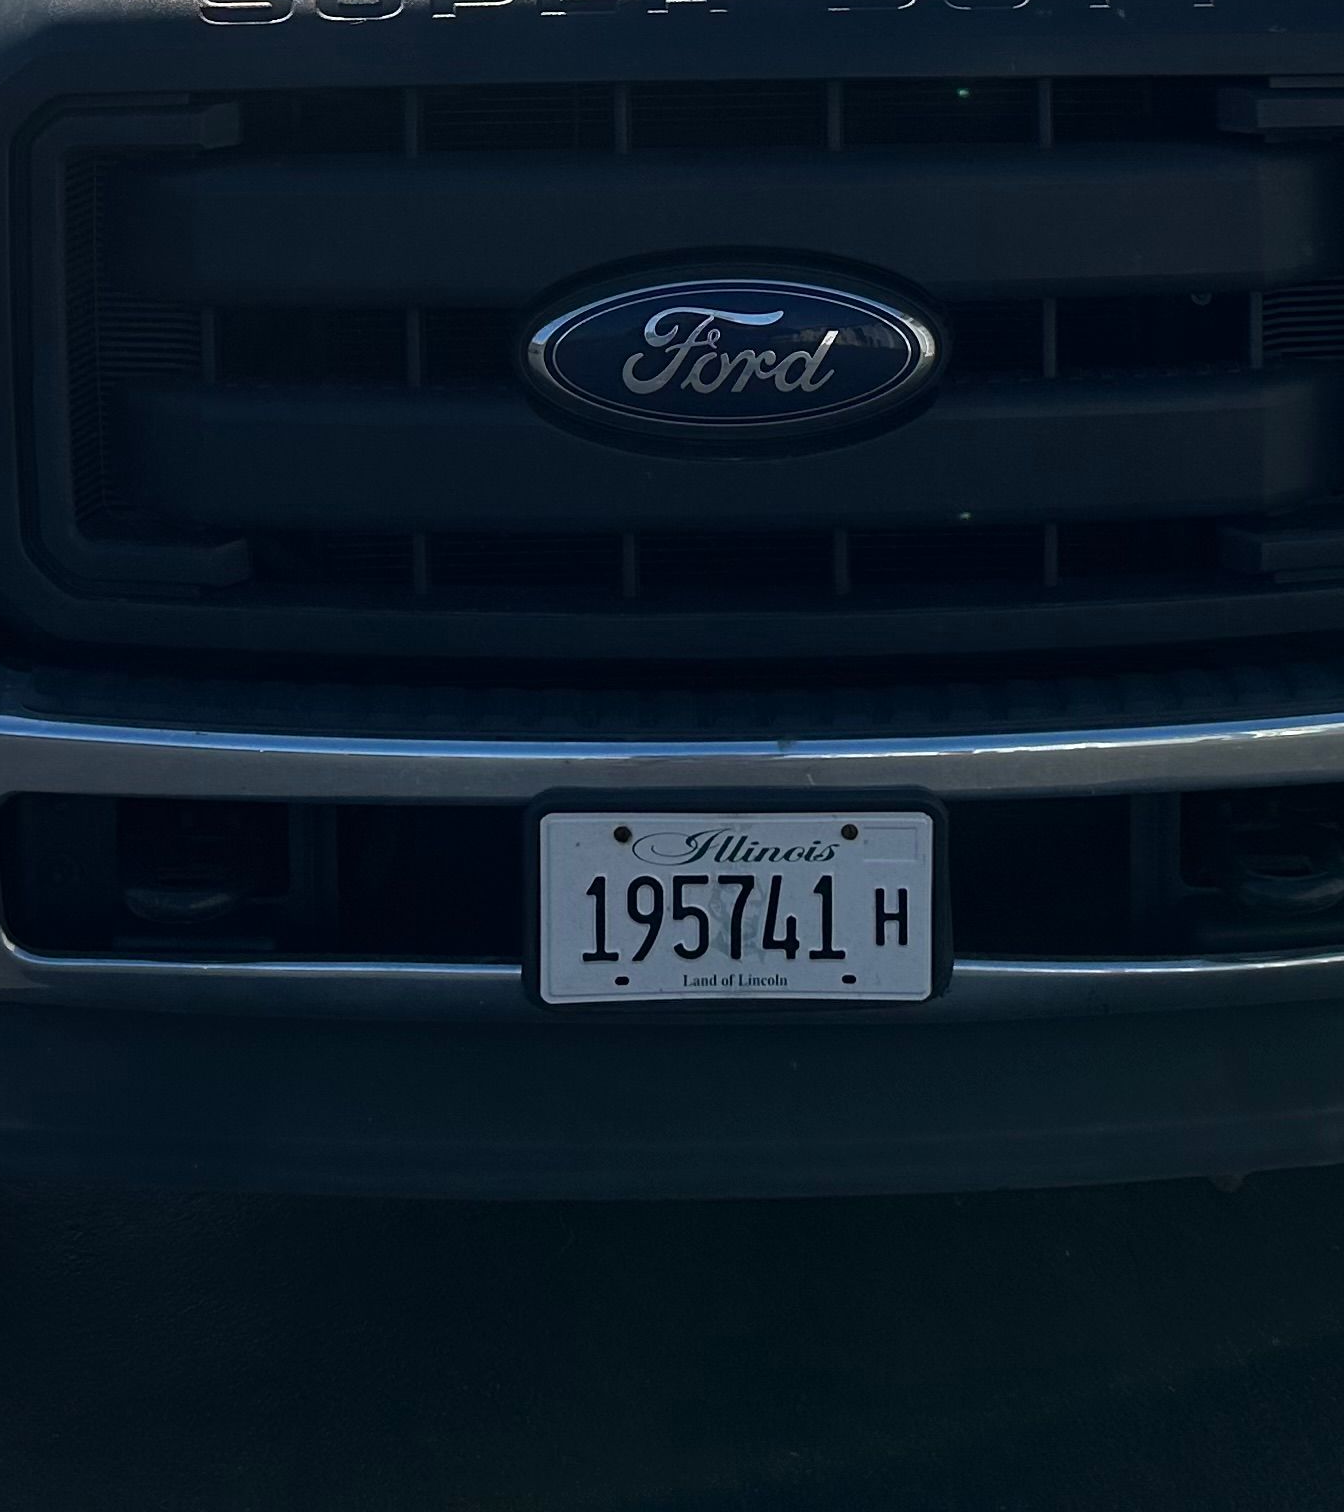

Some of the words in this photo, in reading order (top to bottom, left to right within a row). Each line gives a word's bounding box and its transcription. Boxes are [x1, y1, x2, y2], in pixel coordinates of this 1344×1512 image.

[622, 306, 839, 395] Ford
[631, 827, 840, 866] Illinois
[582, 874, 846, 962] 195741
[875, 888, 909, 947] H
[683, 974, 717, 987] Land
[721, 973, 736, 987] of
[738, 973, 788, 987] Lincoln
